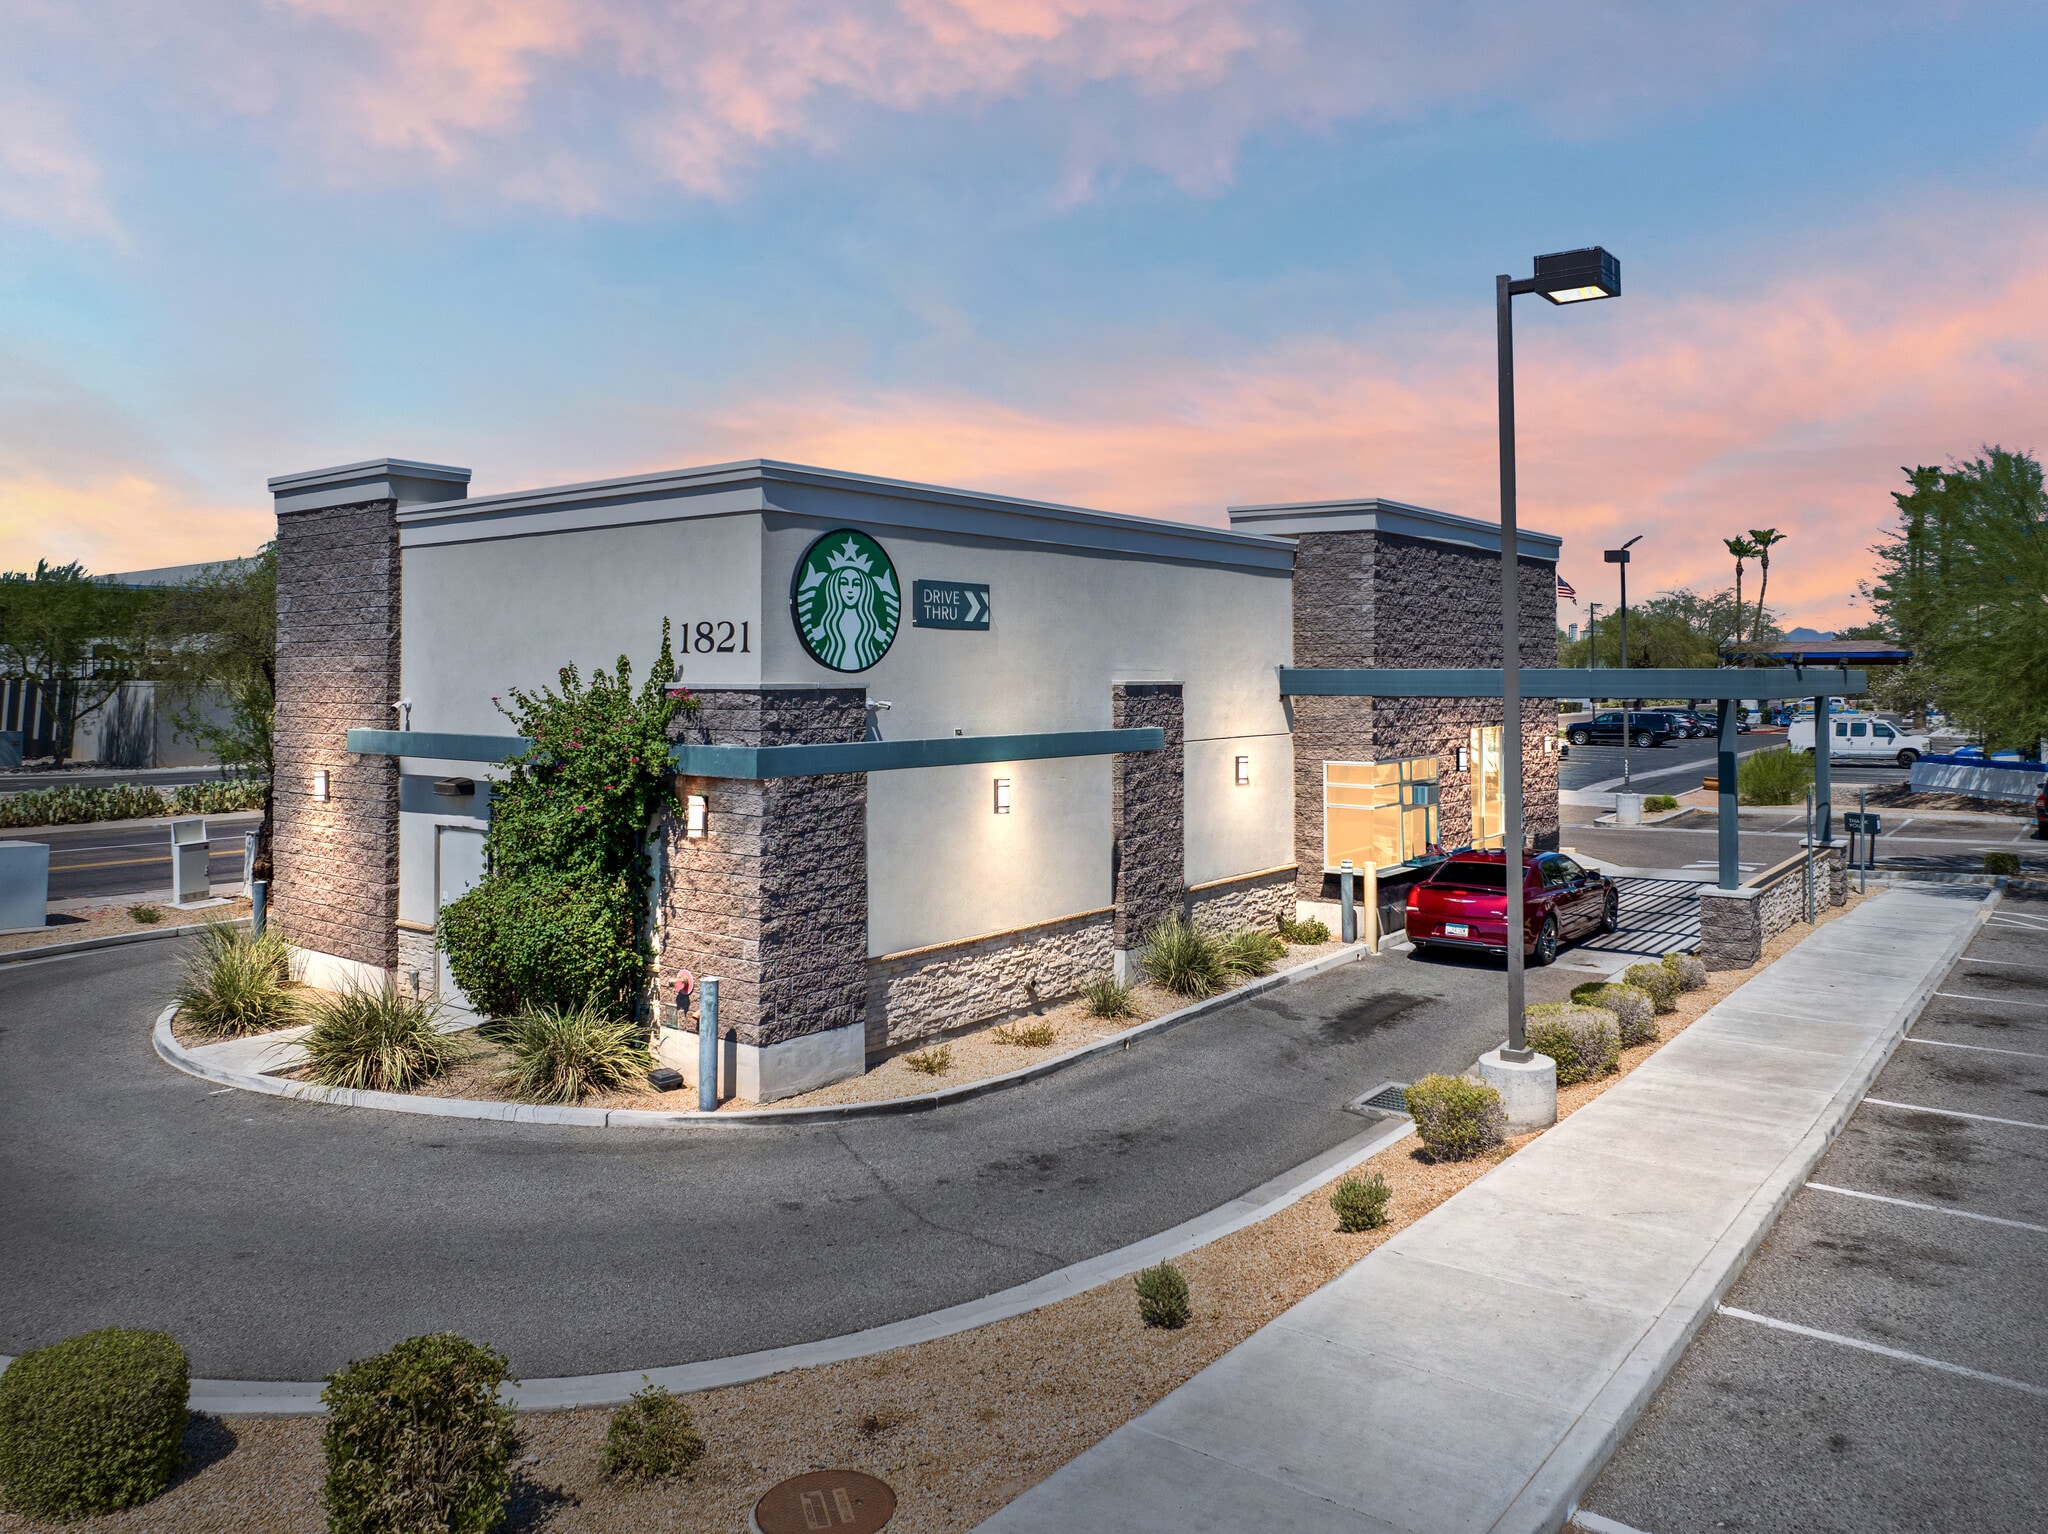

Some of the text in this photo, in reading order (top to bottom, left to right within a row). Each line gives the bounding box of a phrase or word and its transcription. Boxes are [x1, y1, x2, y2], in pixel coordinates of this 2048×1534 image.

[923, 588, 960, 605] DRIVE
[923, 604, 958, 621] THRU
[680, 620, 751, 654] 1821
